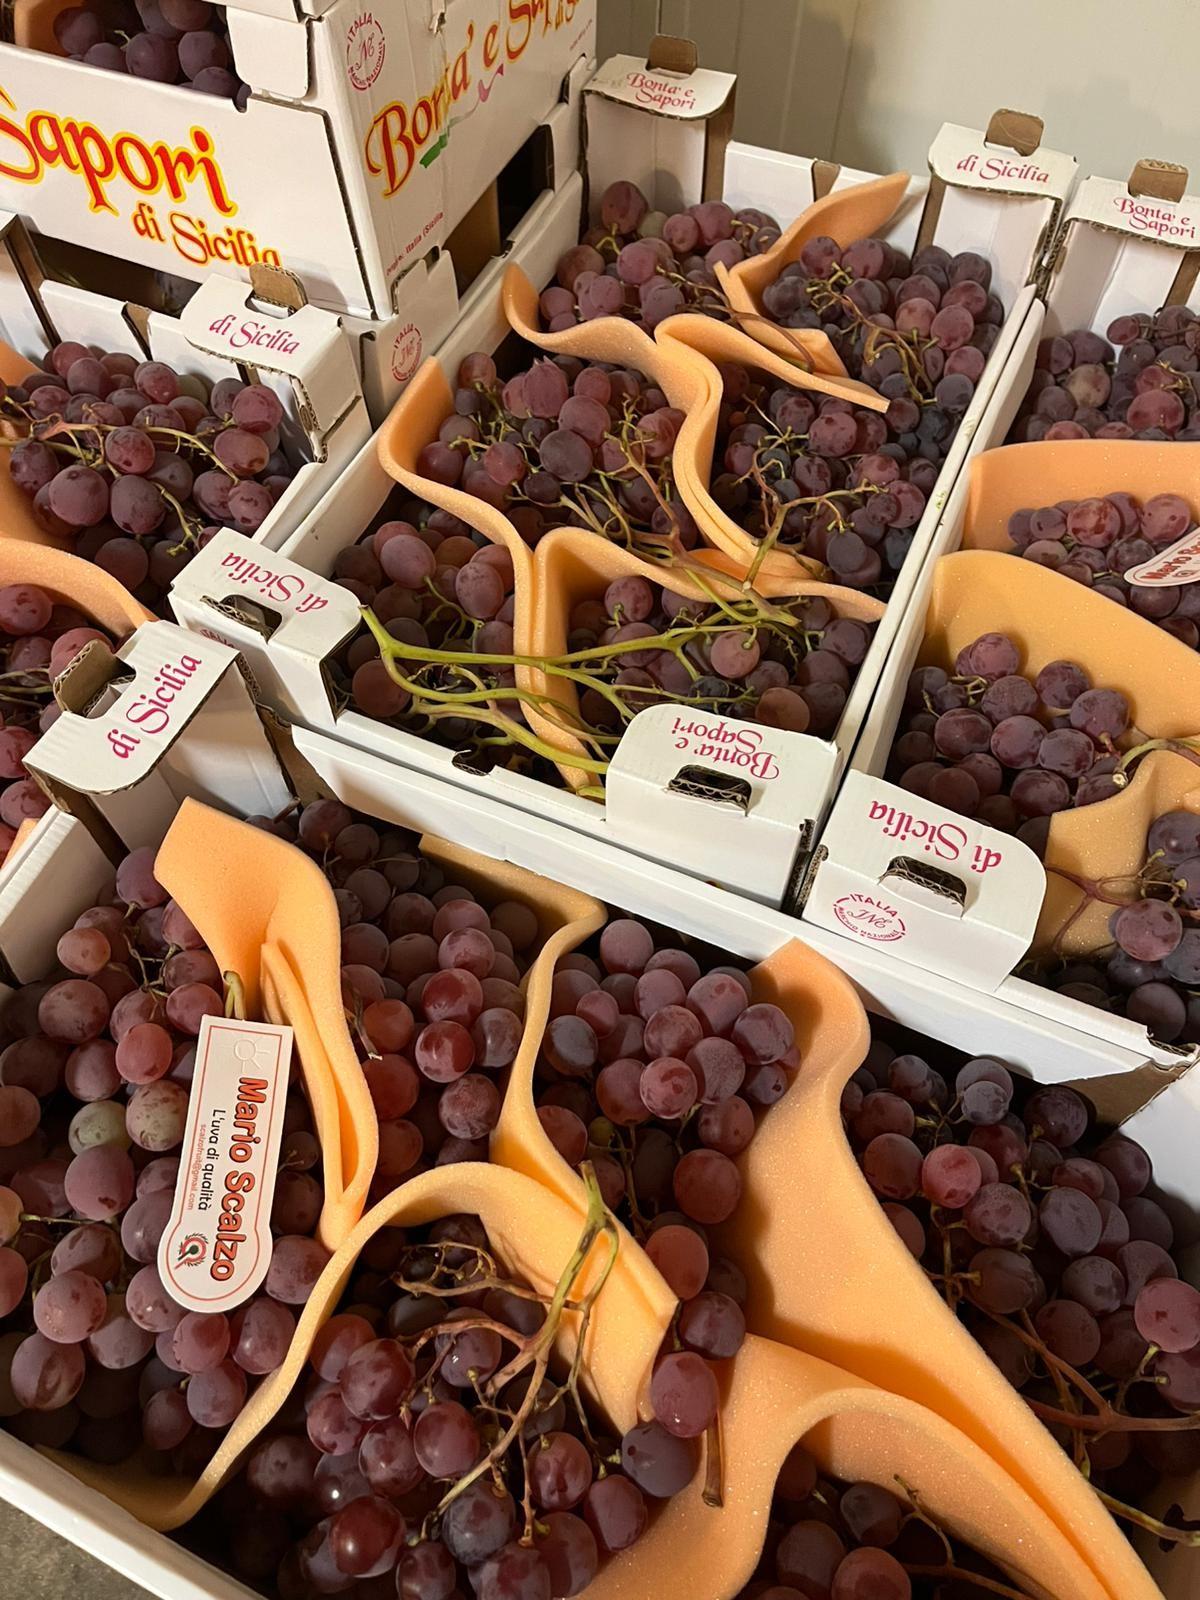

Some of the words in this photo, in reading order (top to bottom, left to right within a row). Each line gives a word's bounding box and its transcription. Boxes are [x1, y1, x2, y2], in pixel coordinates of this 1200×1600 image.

[347, 12, 373, 43] ITALIA
[484, 22, 499, 69] e
[635, 87, 697, 110] Sapori
[684, 88, 694, 98] e
[956, 154, 979, 172] di
[979, 158, 1049, 183] Sicilia
[131, 201, 166, 244] di
[1129, 213, 1196, 239] Sapori
[1180, 216, 1190, 226] e
[209, 314, 237, 335] di
[229, 321, 300, 354] Sicilia
[221, 552, 305, 602] Sicilia
[295, 593, 329, 613] di
[107, 729, 141, 759] di
[126, 654, 202, 734] Sicilia
[671, 717, 763, 755] Sapori
[675, 737, 689, 749] e
[694, 744, 779, 780] Bonta'
[868, 800, 968, 860] Sicilia
[971, 845, 1002, 873] di
[850, 894, 898, 917] ITALIA
[228, 1077, 269, 1163] Mario
[206, 1147, 220, 1161] di
[198, 1163, 215, 1211] qualità
[210, 1169, 256, 1281] Scalzo
